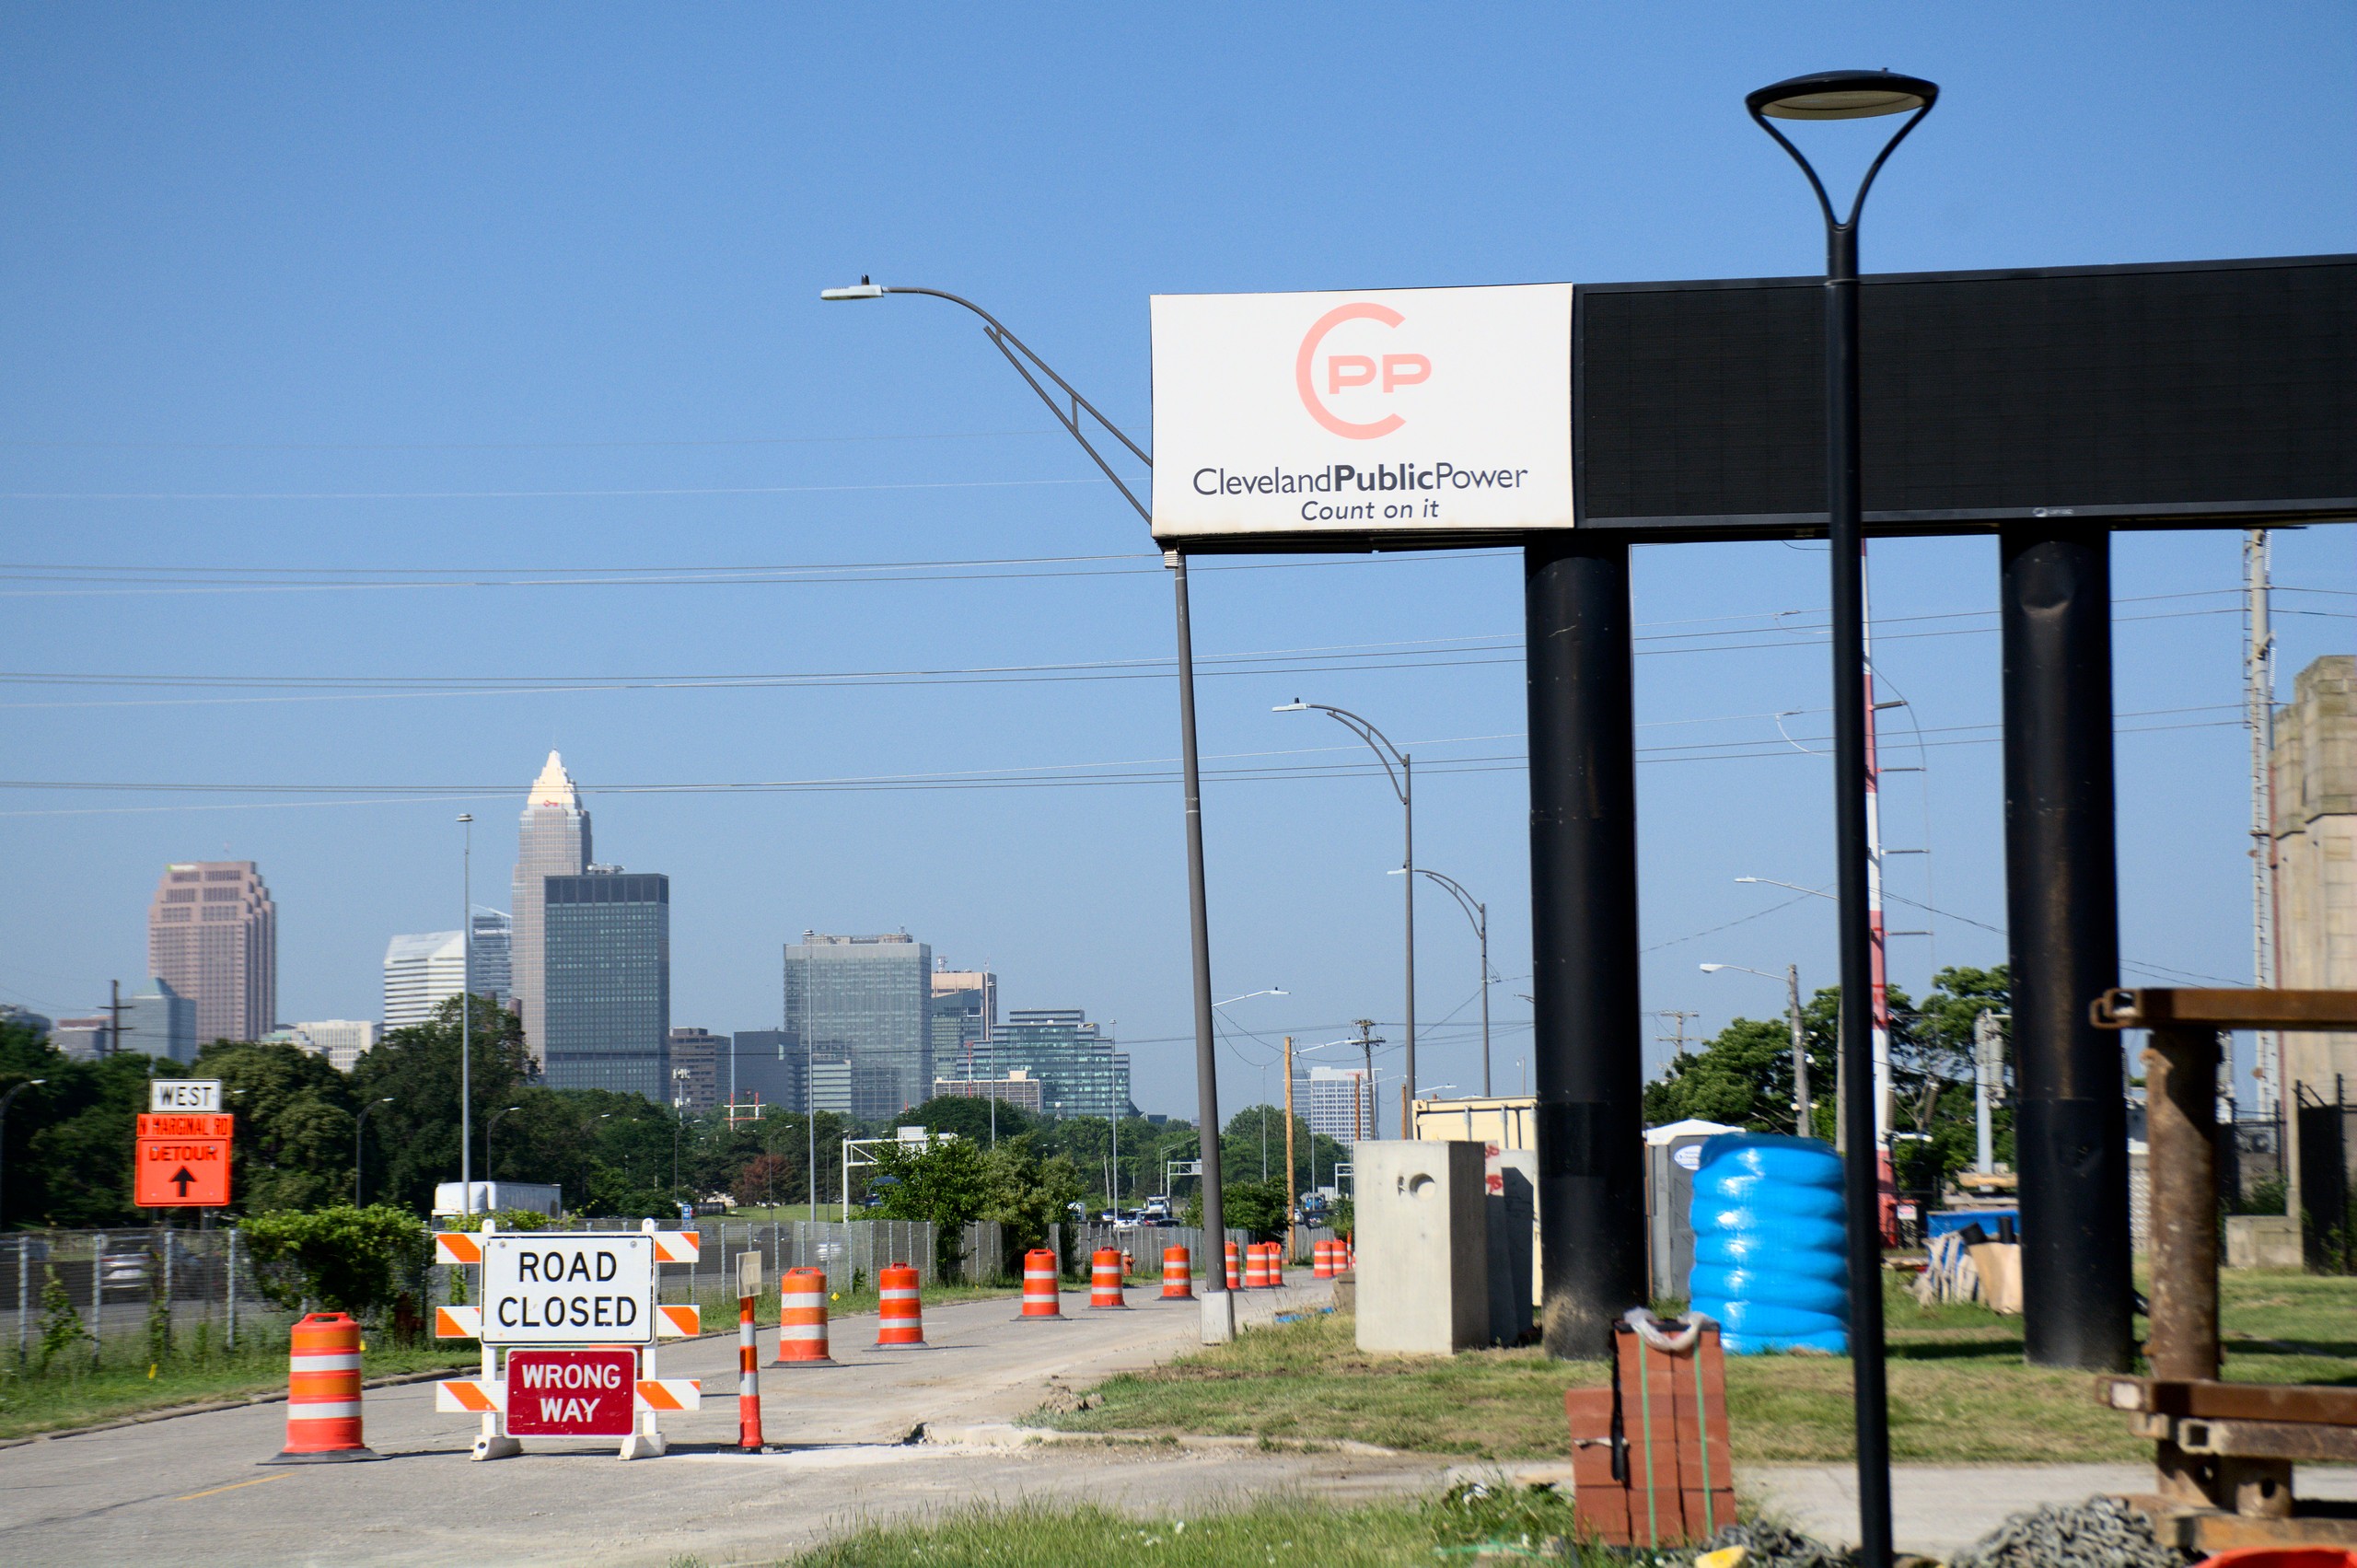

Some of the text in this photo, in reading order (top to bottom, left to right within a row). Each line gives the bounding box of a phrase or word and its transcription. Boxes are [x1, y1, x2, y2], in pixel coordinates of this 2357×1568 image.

[1296, 302, 1432, 440] CPP
[1301, 498, 1439, 521] Count on it
[160, 1086, 212, 1106] WEST
[138, 1118, 228, 1135] N MARGINAL RD
[149, 1146, 217, 1161] DETOUR
[518, 1251, 617, 1282] ROAD
[498, 1296, 636, 1327] CLOSED
[521, 1365, 621, 1389] WRONG
[540, 1398, 601, 1423] WAY
